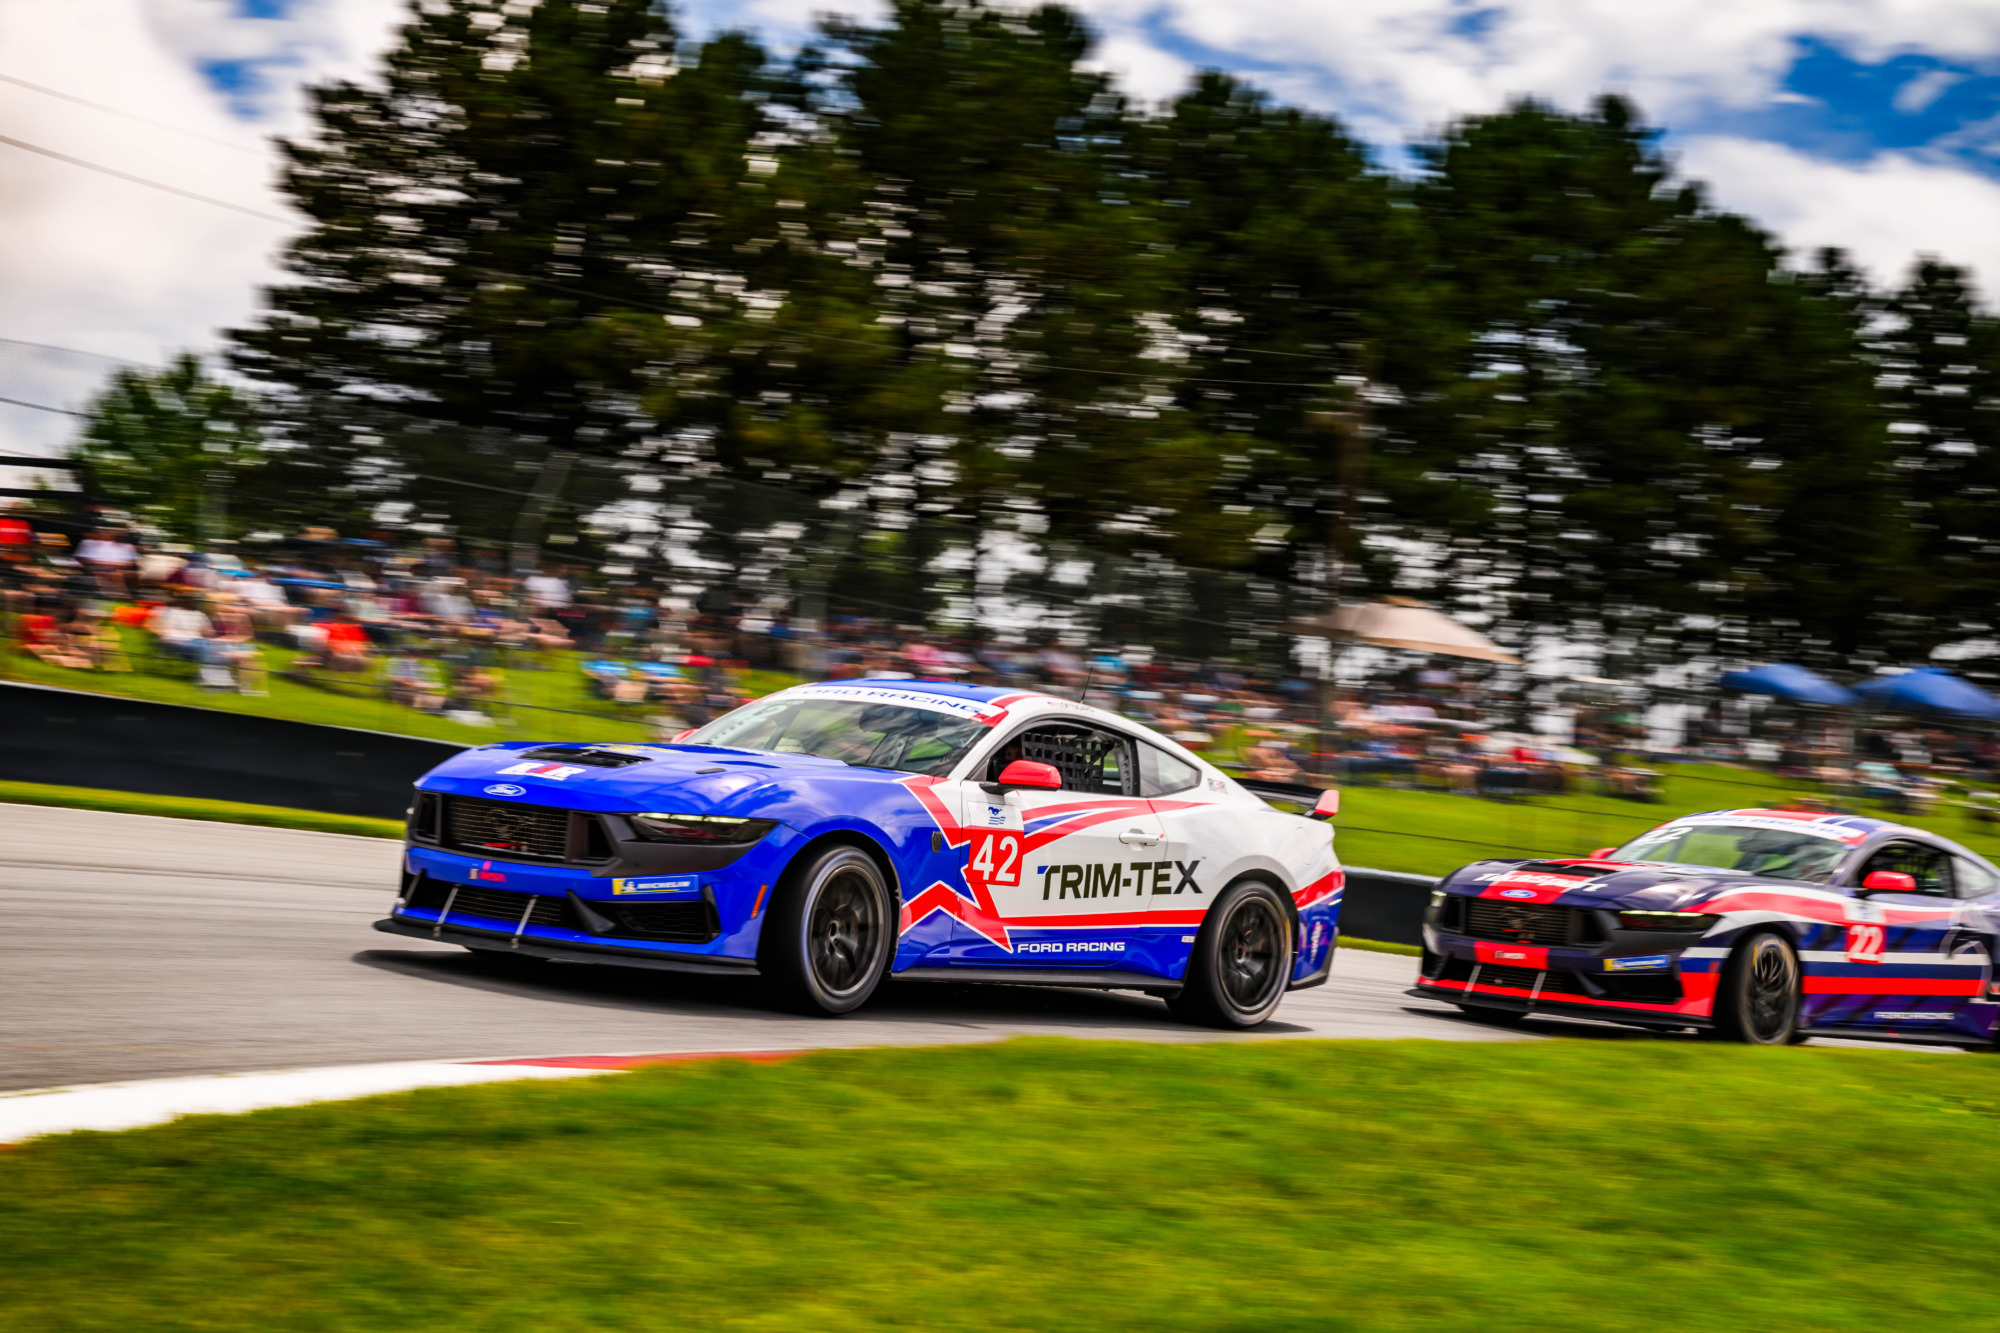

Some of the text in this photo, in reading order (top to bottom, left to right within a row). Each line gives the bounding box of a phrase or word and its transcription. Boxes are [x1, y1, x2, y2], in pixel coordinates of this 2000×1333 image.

[867, 690, 983, 713] RACING
[972, 834, 1018, 882] 42
[1037, 860, 1203, 900] TRIM-TEX
[1017, 942, 1125, 953] FORD RACING
[1848, 925, 1883, 960] 22
